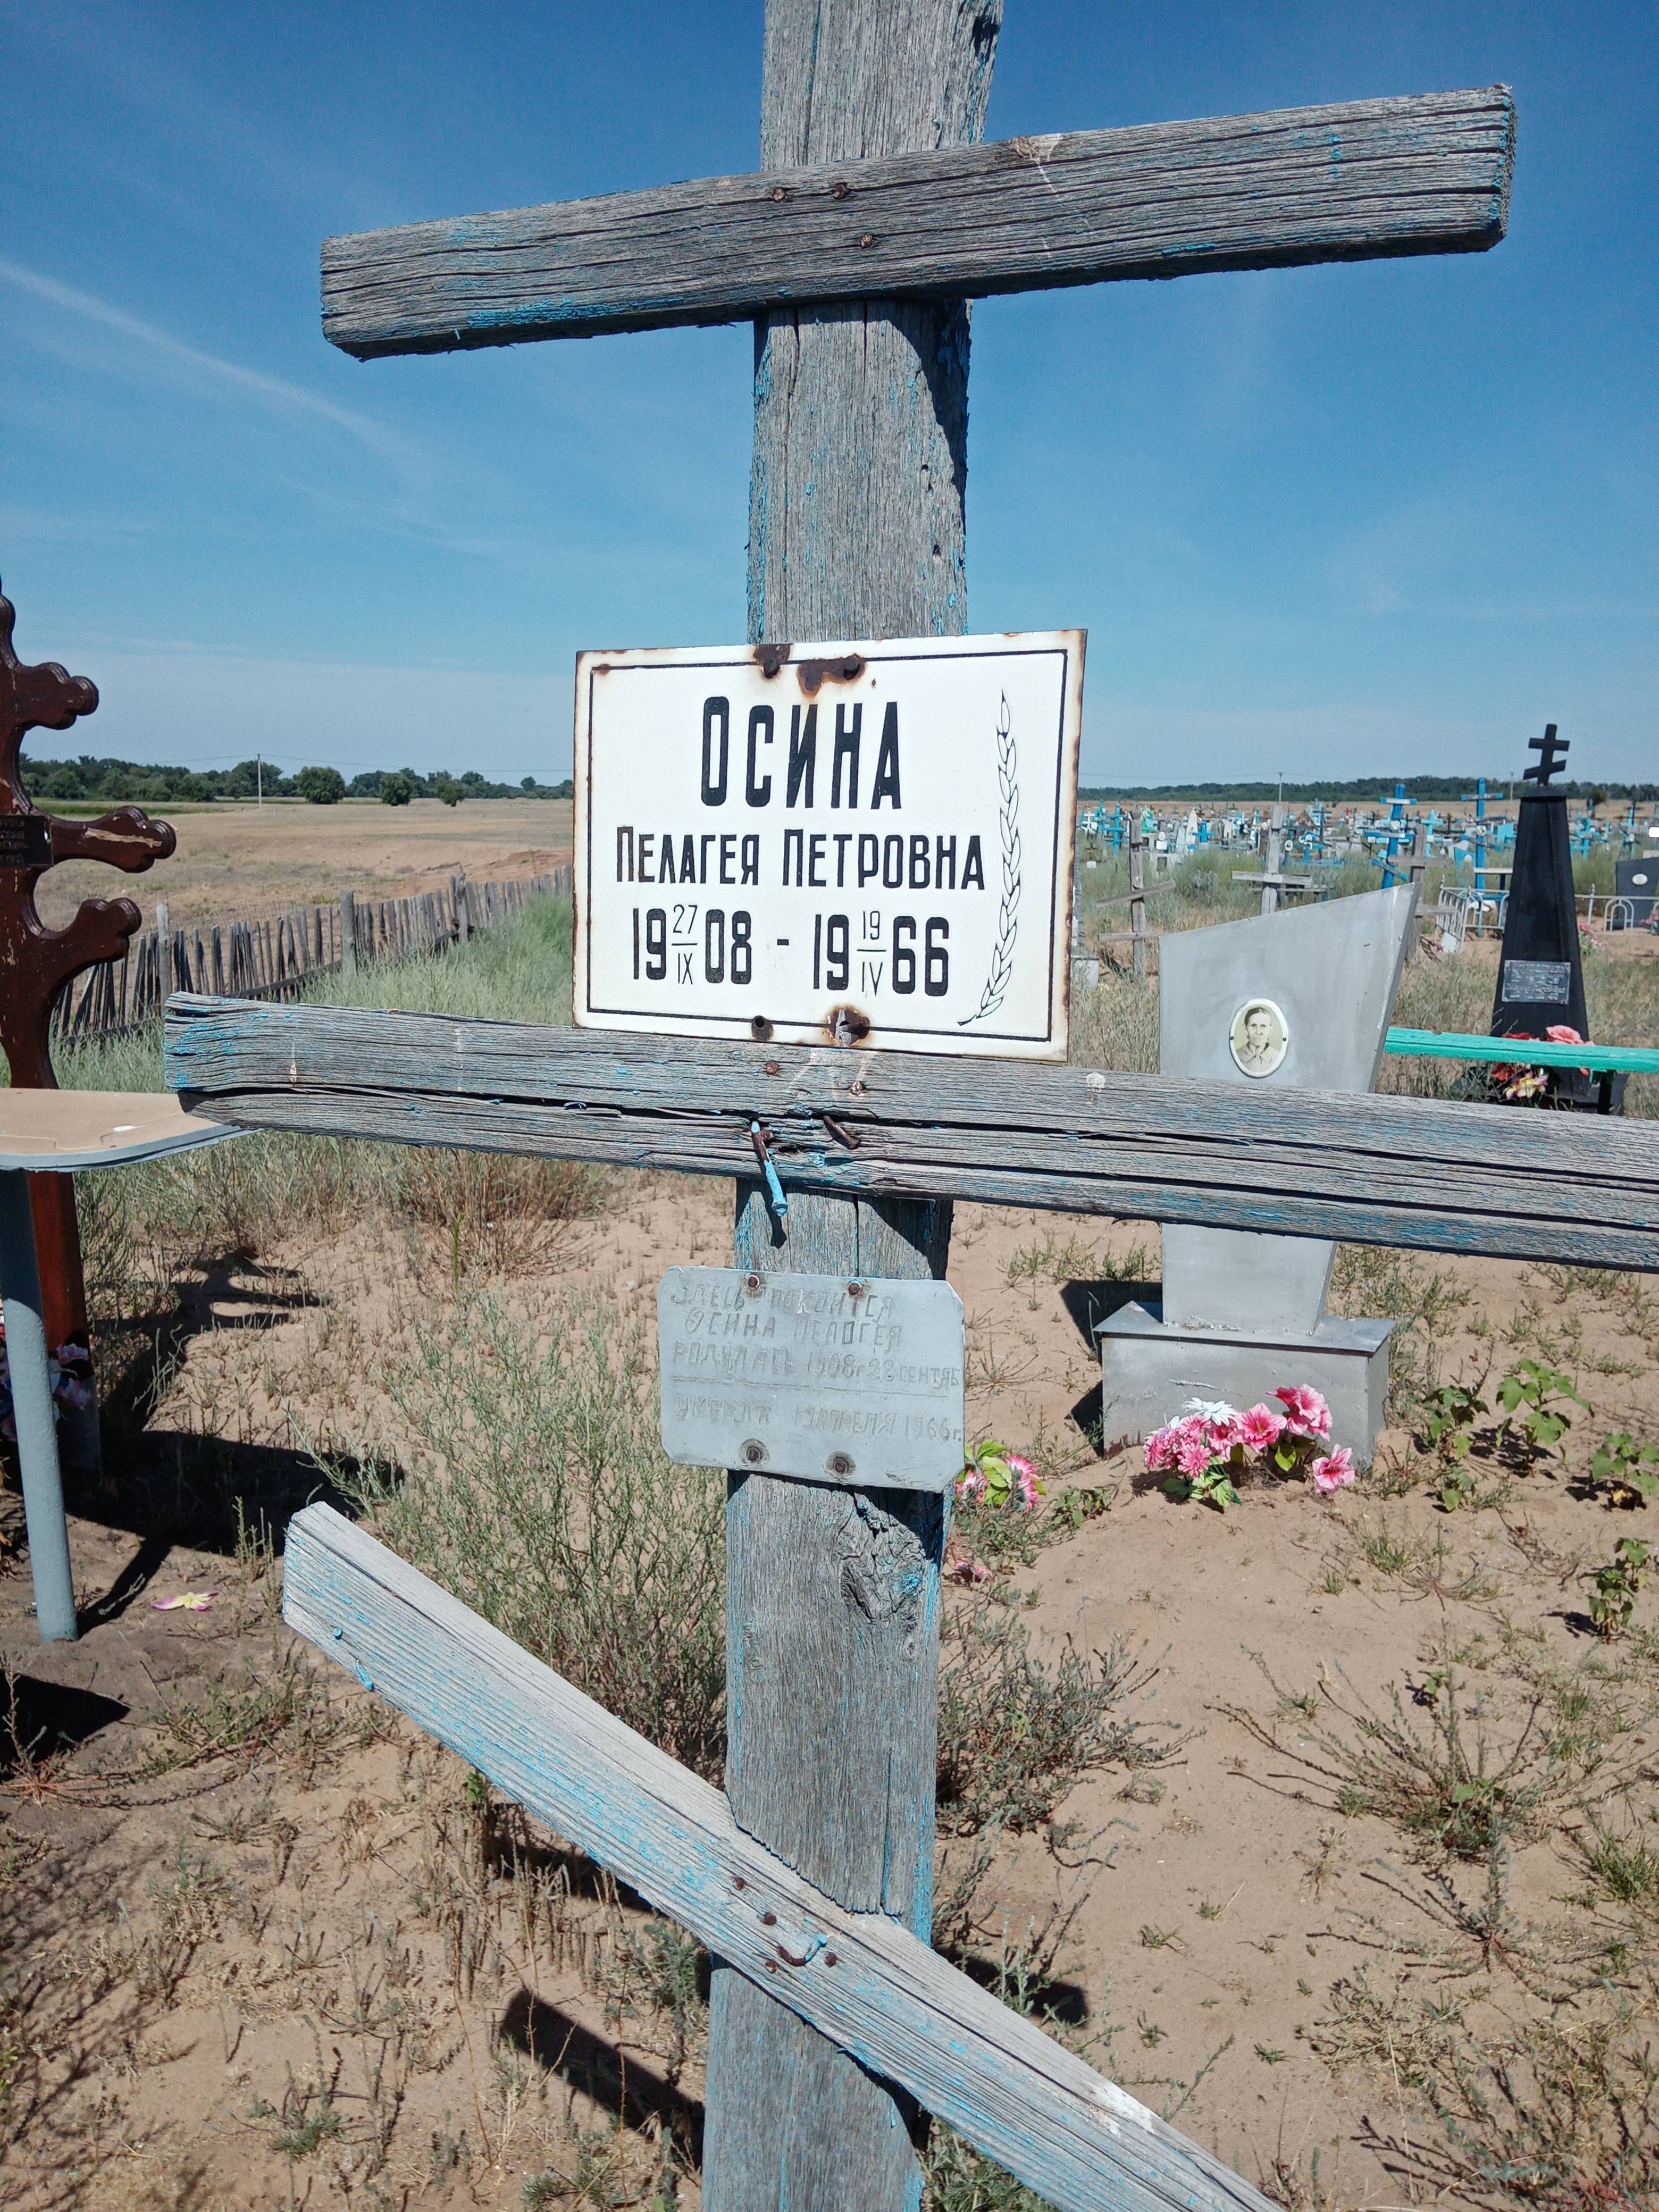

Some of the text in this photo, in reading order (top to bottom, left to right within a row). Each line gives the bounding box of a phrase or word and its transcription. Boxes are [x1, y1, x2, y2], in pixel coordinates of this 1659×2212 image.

[701, 696, 902, 810] ОСИНА
[617, 826, 985, 890] ПЕЛАГЕЯ ПЕТРОВНА
[685, 1307, 776, 1339] ОСИНА
